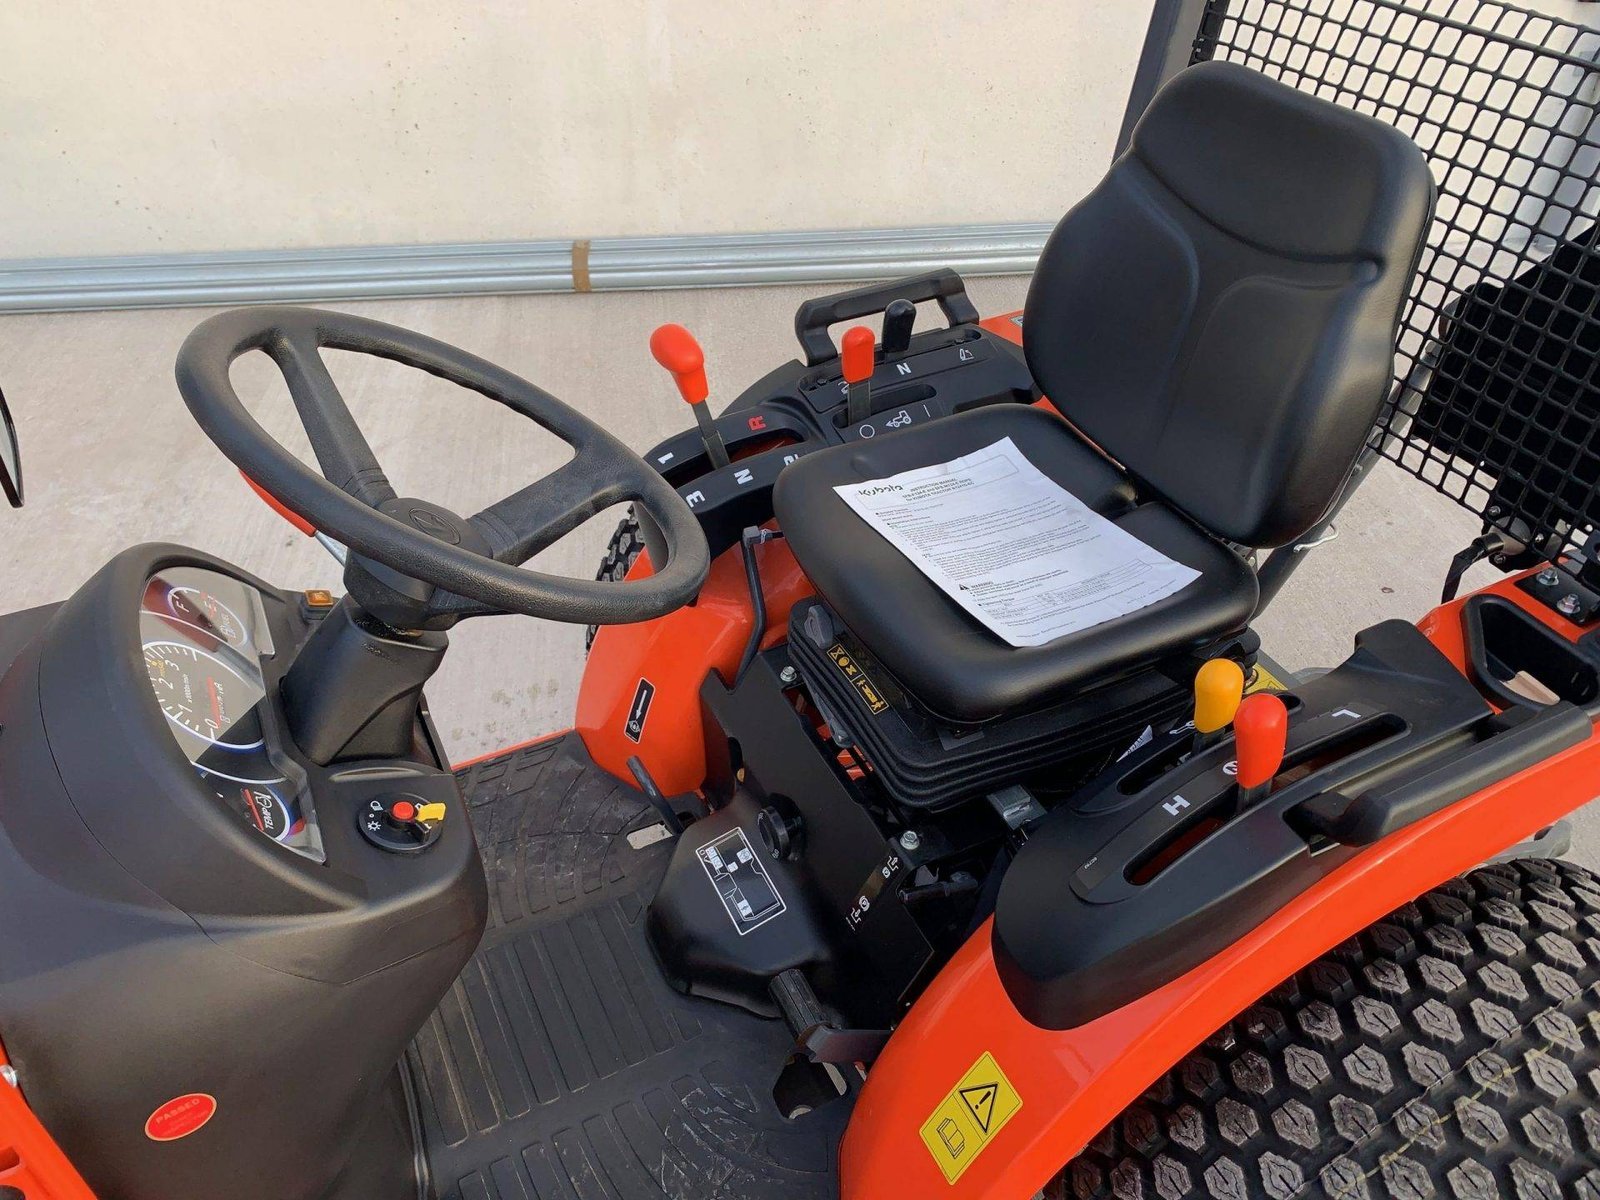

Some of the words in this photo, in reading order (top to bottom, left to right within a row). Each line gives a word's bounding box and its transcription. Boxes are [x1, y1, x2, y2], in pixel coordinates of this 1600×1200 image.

[897, 362, 912, 375] N
[748, 415, 767, 431] R
[733, 468, 754, 485] N
[176, 600, 190, 613] F
[164, 659, 180, 671] 3
[158, 677, 174, 690] 2
[178, 703, 192, 713] 1
[204, 718, 219, 729] 0
[1162, 794, 1191, 816] H
[263, 806, 274, 830] TEMP
